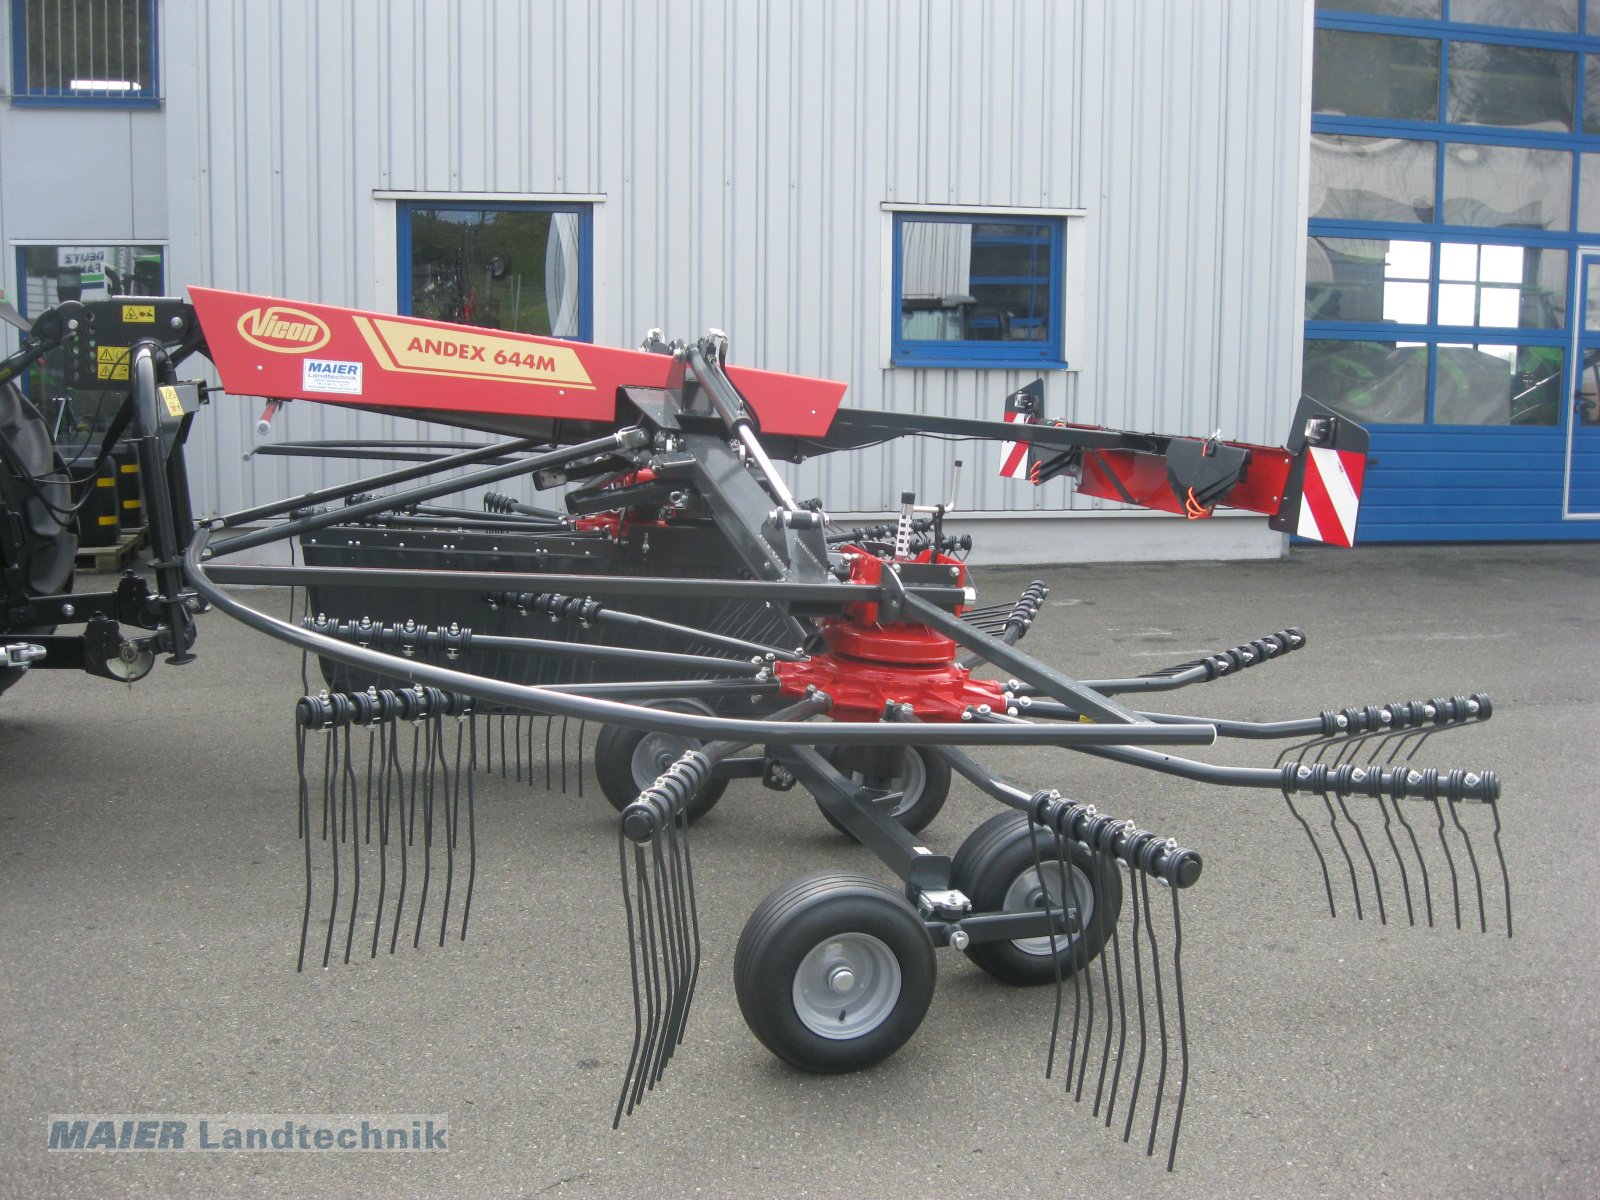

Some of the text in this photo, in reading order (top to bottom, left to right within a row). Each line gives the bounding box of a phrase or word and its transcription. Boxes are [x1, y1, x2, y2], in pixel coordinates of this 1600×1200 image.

[251, 308, 319, 343] Vicon
[407, 336, 556, 373] ANDEX 644M
[308, 362, 358, 375] MAIER
[308, 373, 357, 381] Landtechnik
